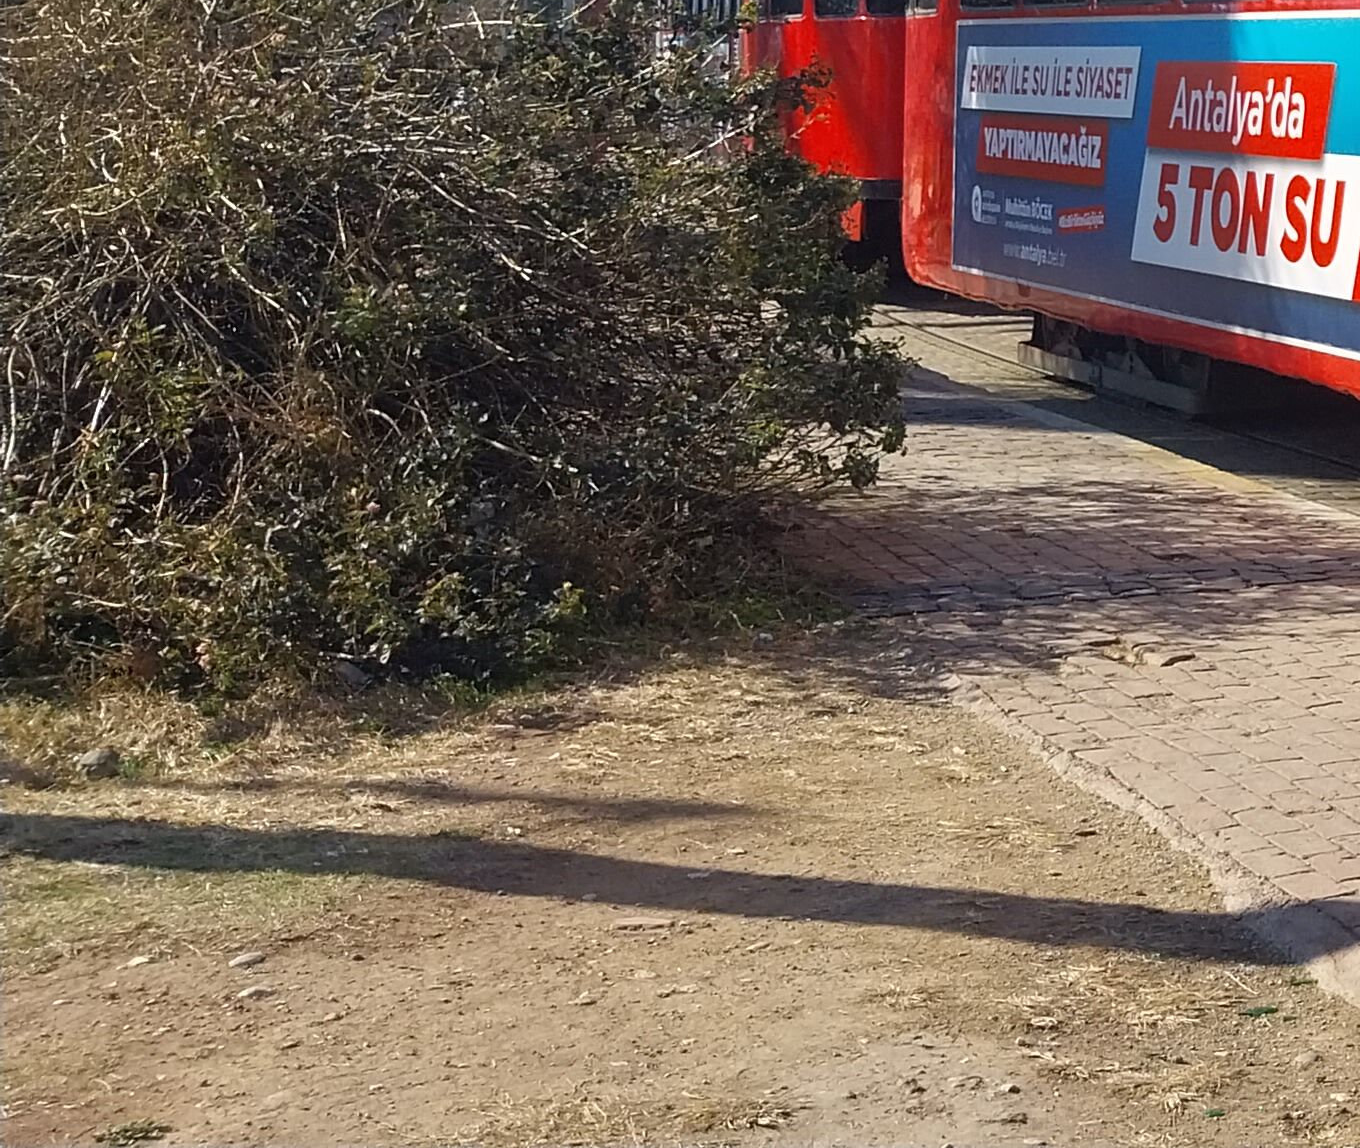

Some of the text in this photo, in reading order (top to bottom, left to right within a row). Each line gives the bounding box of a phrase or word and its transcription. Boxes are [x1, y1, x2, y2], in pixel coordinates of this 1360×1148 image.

[969, 57, 1133, 100] EKMEK İLE SU İLE SİYASET
[1169, 75, 1306, 146] Antalya'da
[984, 125, 1102, 169] YAPTIRMAYACAĞIZ
[1153, 163, 1346, 268] 5 TON SU
